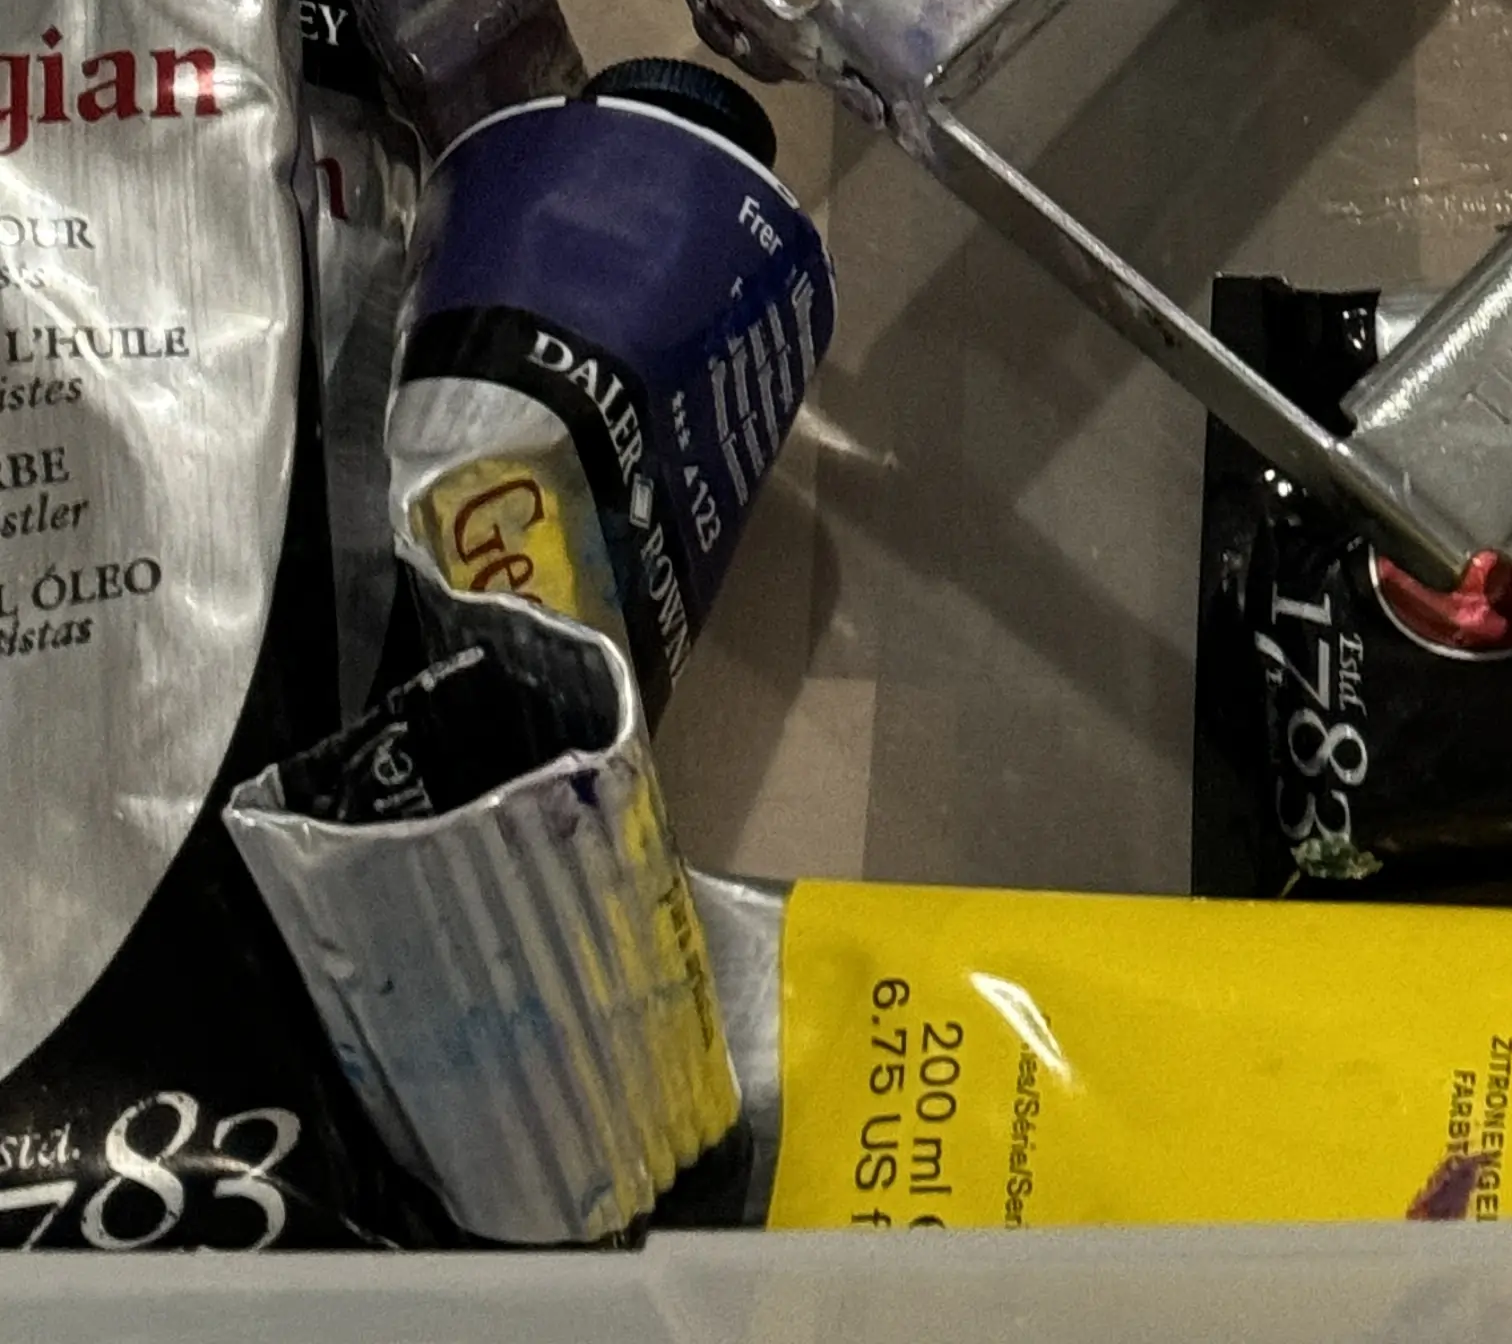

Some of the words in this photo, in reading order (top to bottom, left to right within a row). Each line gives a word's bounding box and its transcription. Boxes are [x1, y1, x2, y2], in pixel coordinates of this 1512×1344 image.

[5, 325, 191, 363] L'HUILE
[526, 327, 645, 487] DALER
[31, 556, 162, 611] ÓLEO
[868, 976, 911, 1095] 6.75
[915, 1020, 964, 1123] 200
[854, 1112, 902, 1191] US
[908, 1136, 953, 1196] ml
